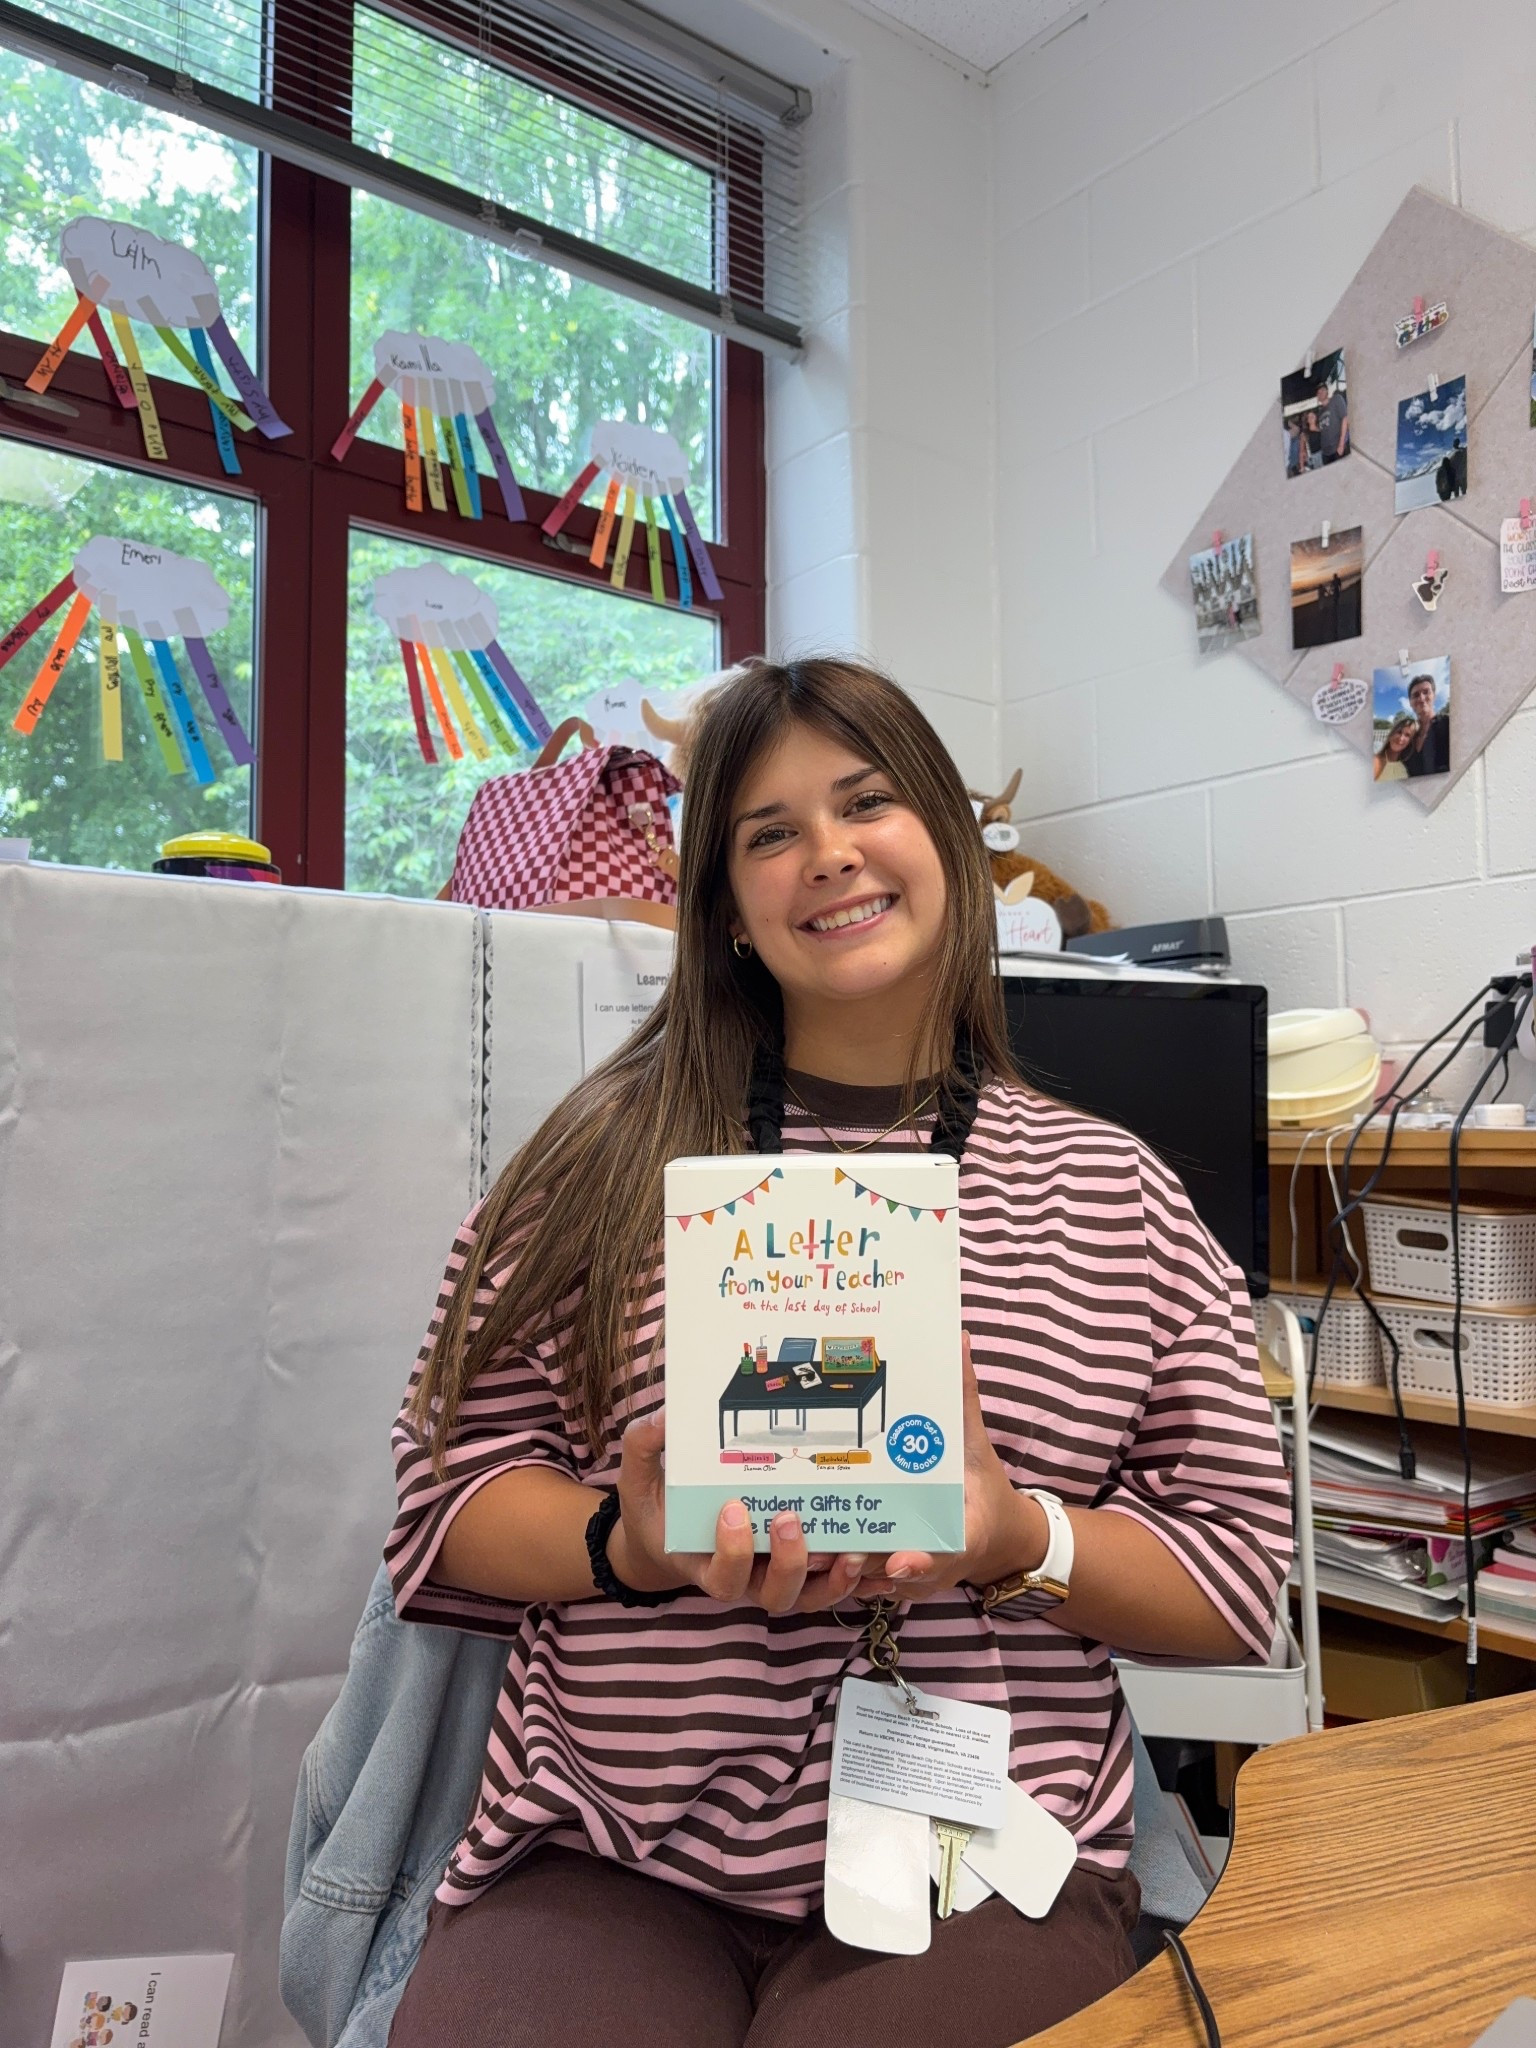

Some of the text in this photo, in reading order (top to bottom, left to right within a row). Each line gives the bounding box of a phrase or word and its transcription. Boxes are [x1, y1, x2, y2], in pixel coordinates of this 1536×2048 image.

[390, 343, 442, 372] Kamilla
[121, 543, 161, 566] Emeri
[1010, 917, 1053, 946] Heart
[600, 1004, 614, 1012] can
[734, 1219, 880, 1260] A Letter
[718, 1260, 904, 1298] from your Teacher
[743, 1298, 880, 1316] on the last day of School
[889, 1420, 942, 1446] Classroom Set of
[902, 1434, 928, 1454] 30
[895, 1454, 938, 1470] Mini Books
[740, 1494, 882, 1512] Student Gifts for
[801, 1518, 896, 1534] of the Year
[855, 1705, 874, 1713] Property
[880, 1710, 897, 1718] Virginia
[858, 1729, 873, 1737] Return
[927, 1744, 944, 1752] Virginia
[145, 1980, 157, 2004] can
[138, 2008, 152, 2038] read
